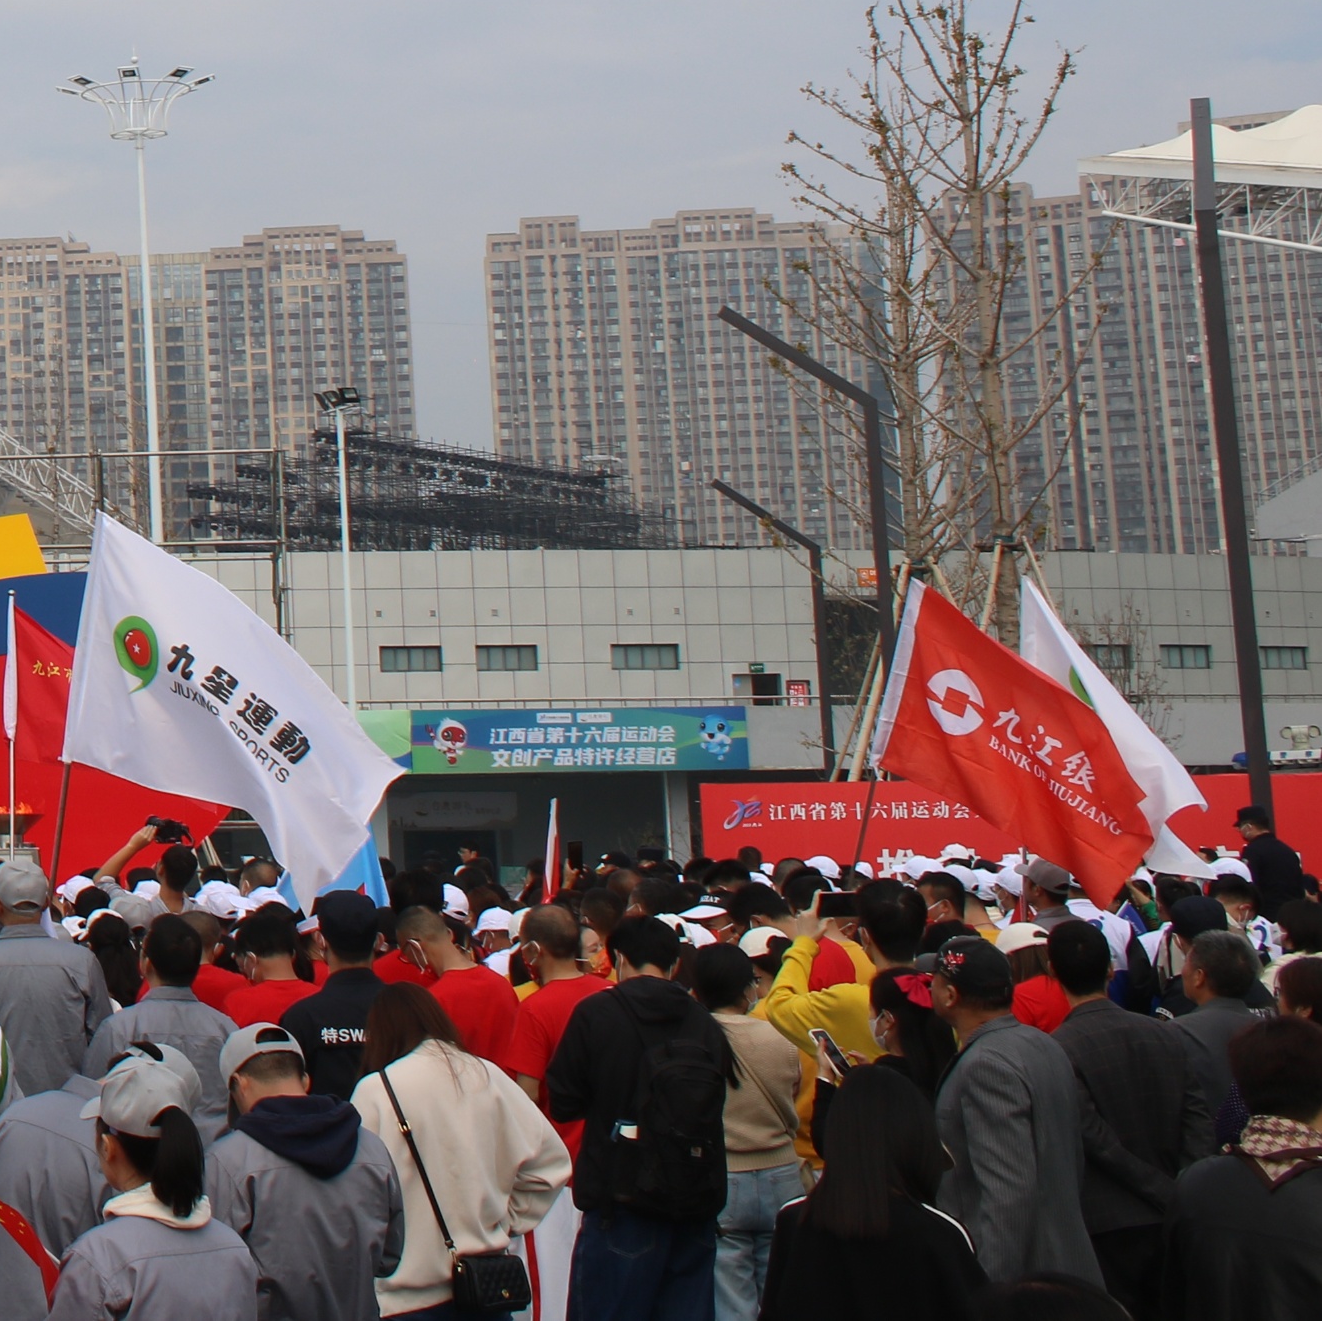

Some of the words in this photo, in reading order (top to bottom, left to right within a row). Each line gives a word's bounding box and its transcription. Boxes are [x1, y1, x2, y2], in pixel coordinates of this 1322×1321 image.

[489, 725, 676, 745] 江西省第十六届运动会
[229, 720, 290, 784] SPORTS
[491, 747, 677, 767] 文创产品特许经营店
[988, 734, 1031, 772] BANK
[1033, 764, 1049, 783] OF
[1047, 778, 1123, 836] JIUJIANG
[769, 800, 980, 821] 江西省第十六届运动会
[321, 1027, 367, 1044] 特SW
